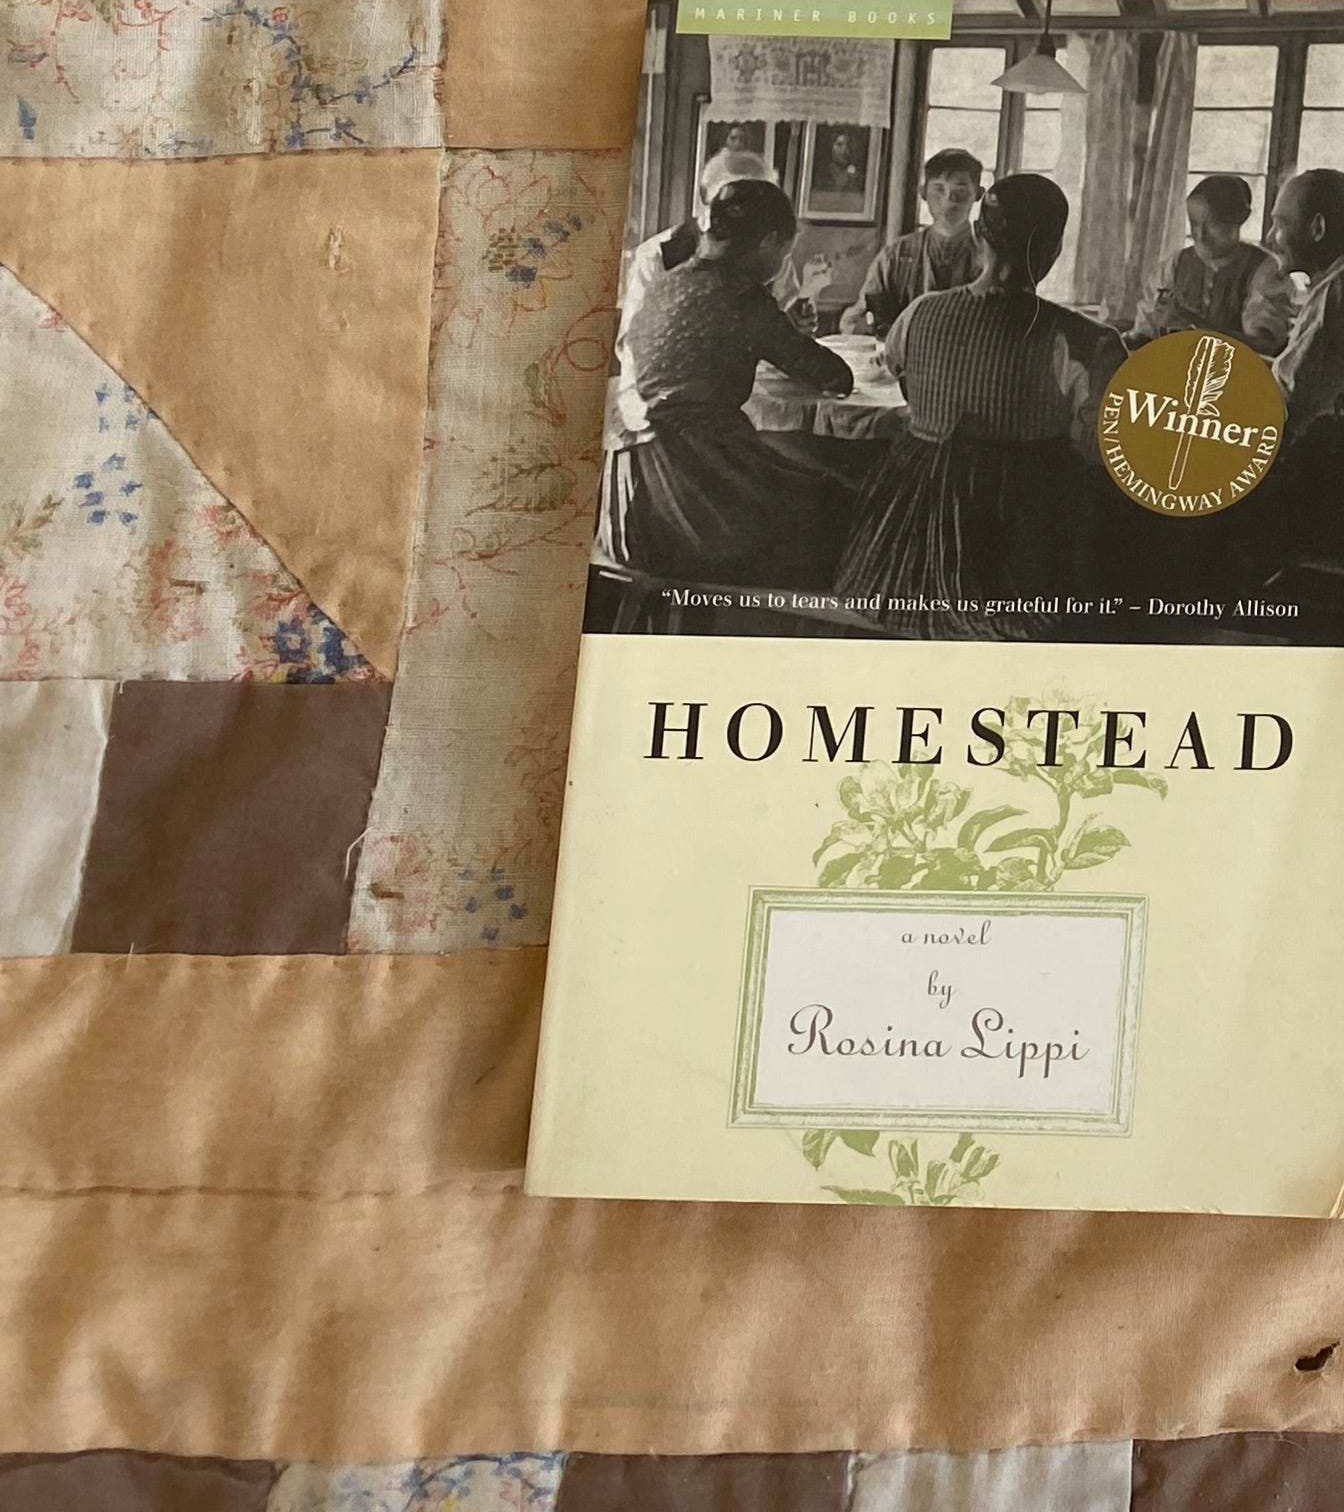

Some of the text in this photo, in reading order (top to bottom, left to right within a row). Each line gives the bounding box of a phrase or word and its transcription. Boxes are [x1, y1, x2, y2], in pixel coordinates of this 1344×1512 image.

[694, 7, 936, 25] MARINER BOOKS
[1126, 388, 1260, 448] Winner
[1229, 425, 1278, 498] AWARD
[661, 589, 732, 608] “Moves
[739, 594, 761, 608] us
[767, 593, 786, 609] to
[791, 593, 839, 609] tears
[845, 593, 881, 610] and
[887, 593, 951, 612] makes
[957, 597, 979, 612] us
[984, 595, 1059, 616] grateful
[1065, 596, 1094, 615] for
[1148, 597, 1226, 621] Dorothy
[1232, 599, 1299, 618] Allison
[642, 700, 1294, 771] HOMESTEAD
[901, 919, 992, 947] a novel
[926, 969, 958, 1008] by
[787, 1002, 1090, 1079] Rosina Lippi
